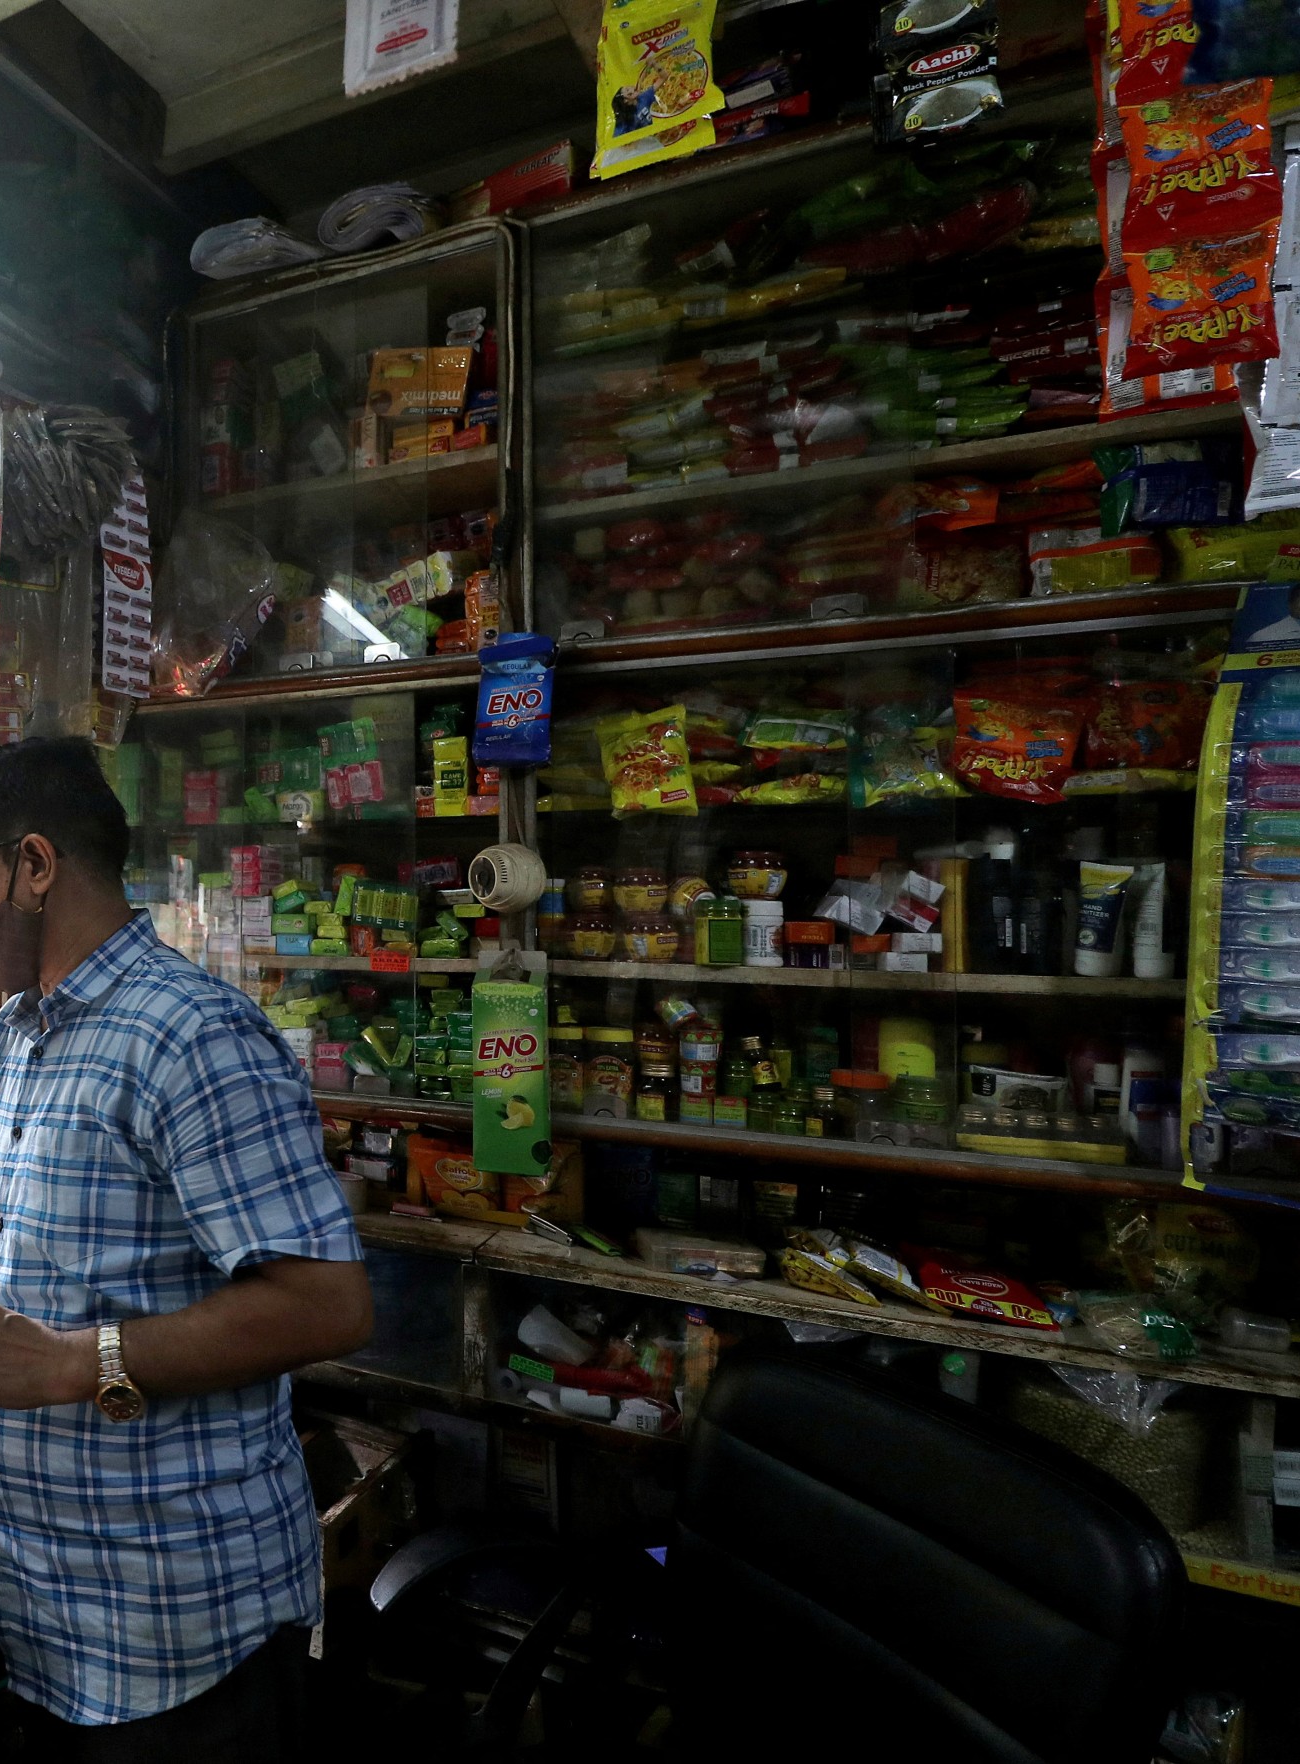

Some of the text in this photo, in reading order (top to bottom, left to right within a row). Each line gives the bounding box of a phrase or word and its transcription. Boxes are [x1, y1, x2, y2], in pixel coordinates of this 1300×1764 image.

[915, 45, 974, 73] Aachi
[903, 81, 925, 93] Black
[926, 74, 956, 88] Pepper
[957, 64, 990, 78] Powder
[401, 390, 460, 405] medimix
[114, 563, 140, 580] EVEREADY
[487, 688, 544, 716] ENO
[478, 1033, 538, 1060] ENO
[442, 1165, 477, 1177] Saffola
